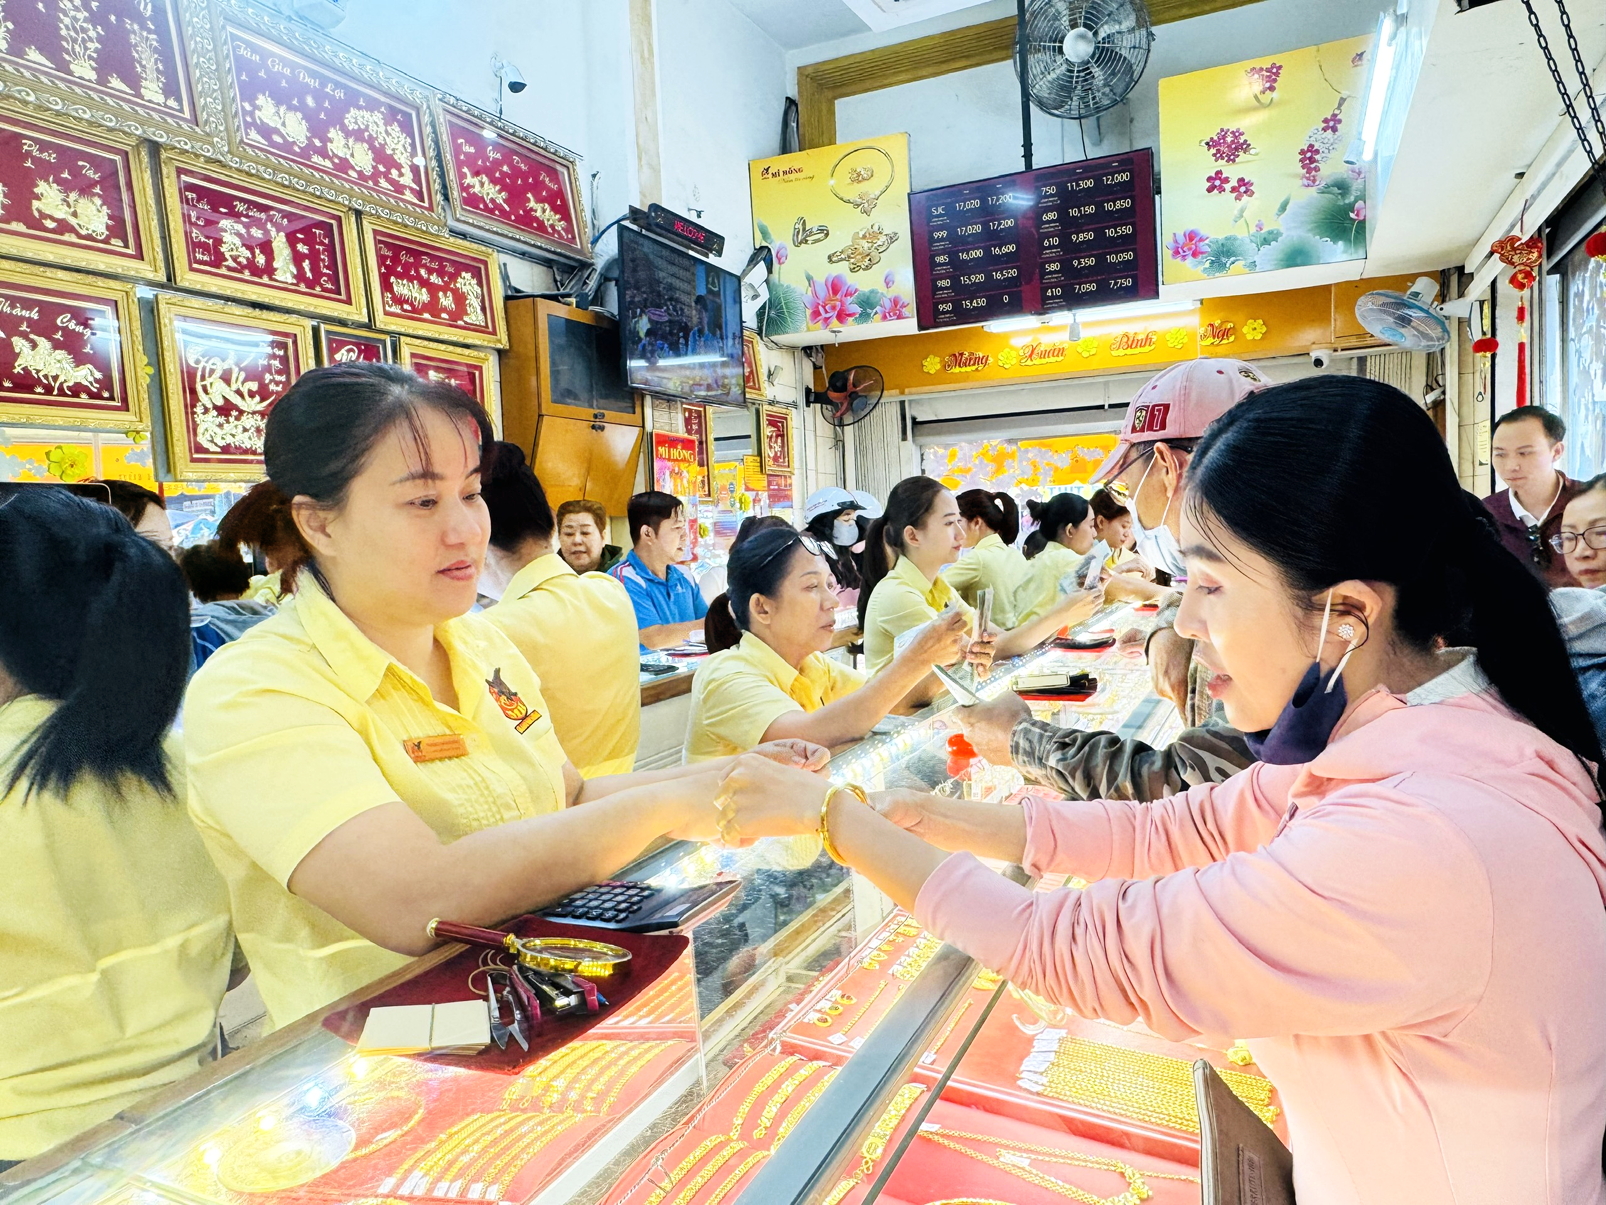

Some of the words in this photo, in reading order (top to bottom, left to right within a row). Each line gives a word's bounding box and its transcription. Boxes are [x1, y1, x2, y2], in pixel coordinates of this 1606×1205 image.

[1041, 186, 1056, 195] 750
[1067, 179, 1094, 191] 11,300
[1102, 172, 1130, 185] 12,000
[931, 206, 946, 215] SJC
[955, 199, 980, 211] 17,020
[987, 193, 1013, 205] 17,200
[1042, 211, 1058, 221] 680
[1068, 205, 1095, 217] 10,150
[1103, 198, 1131, 211] 10,850
[933, 230, 947, 239] 999
[957, 224, 982, 236] 17,020
[989, 218, 1014, 230] 17,200
[1043, 237, 1059, 247] 610
[1071, 231, 1094, 243] 9,850
[1105, 225, 1132, 237] 10,550
[935, 254, 949, 263] 985
[958, 249, 983, 260] 16,000
[991, 244, 1016, 255] 16,600
[1045, 262, 1060, 272] 580
[1072, 257, 1096, 268] 9,350
[1106, 251, 1134, 263] 10,050
[936, 279, 951, 288] 980
[960, 274, 985, 285] 15,920
[992, 268, 1018, 280] 16,520
[1046, 287, 1062, 296] 410
[1074, 282, 1097, 294] 7,050
[1109, 278, 1132, 290] 7,750
[938, 302, 952, 311] 950
[962, 298, 987, 309] 15,430
[1003, 295, 1009, 303] 0
